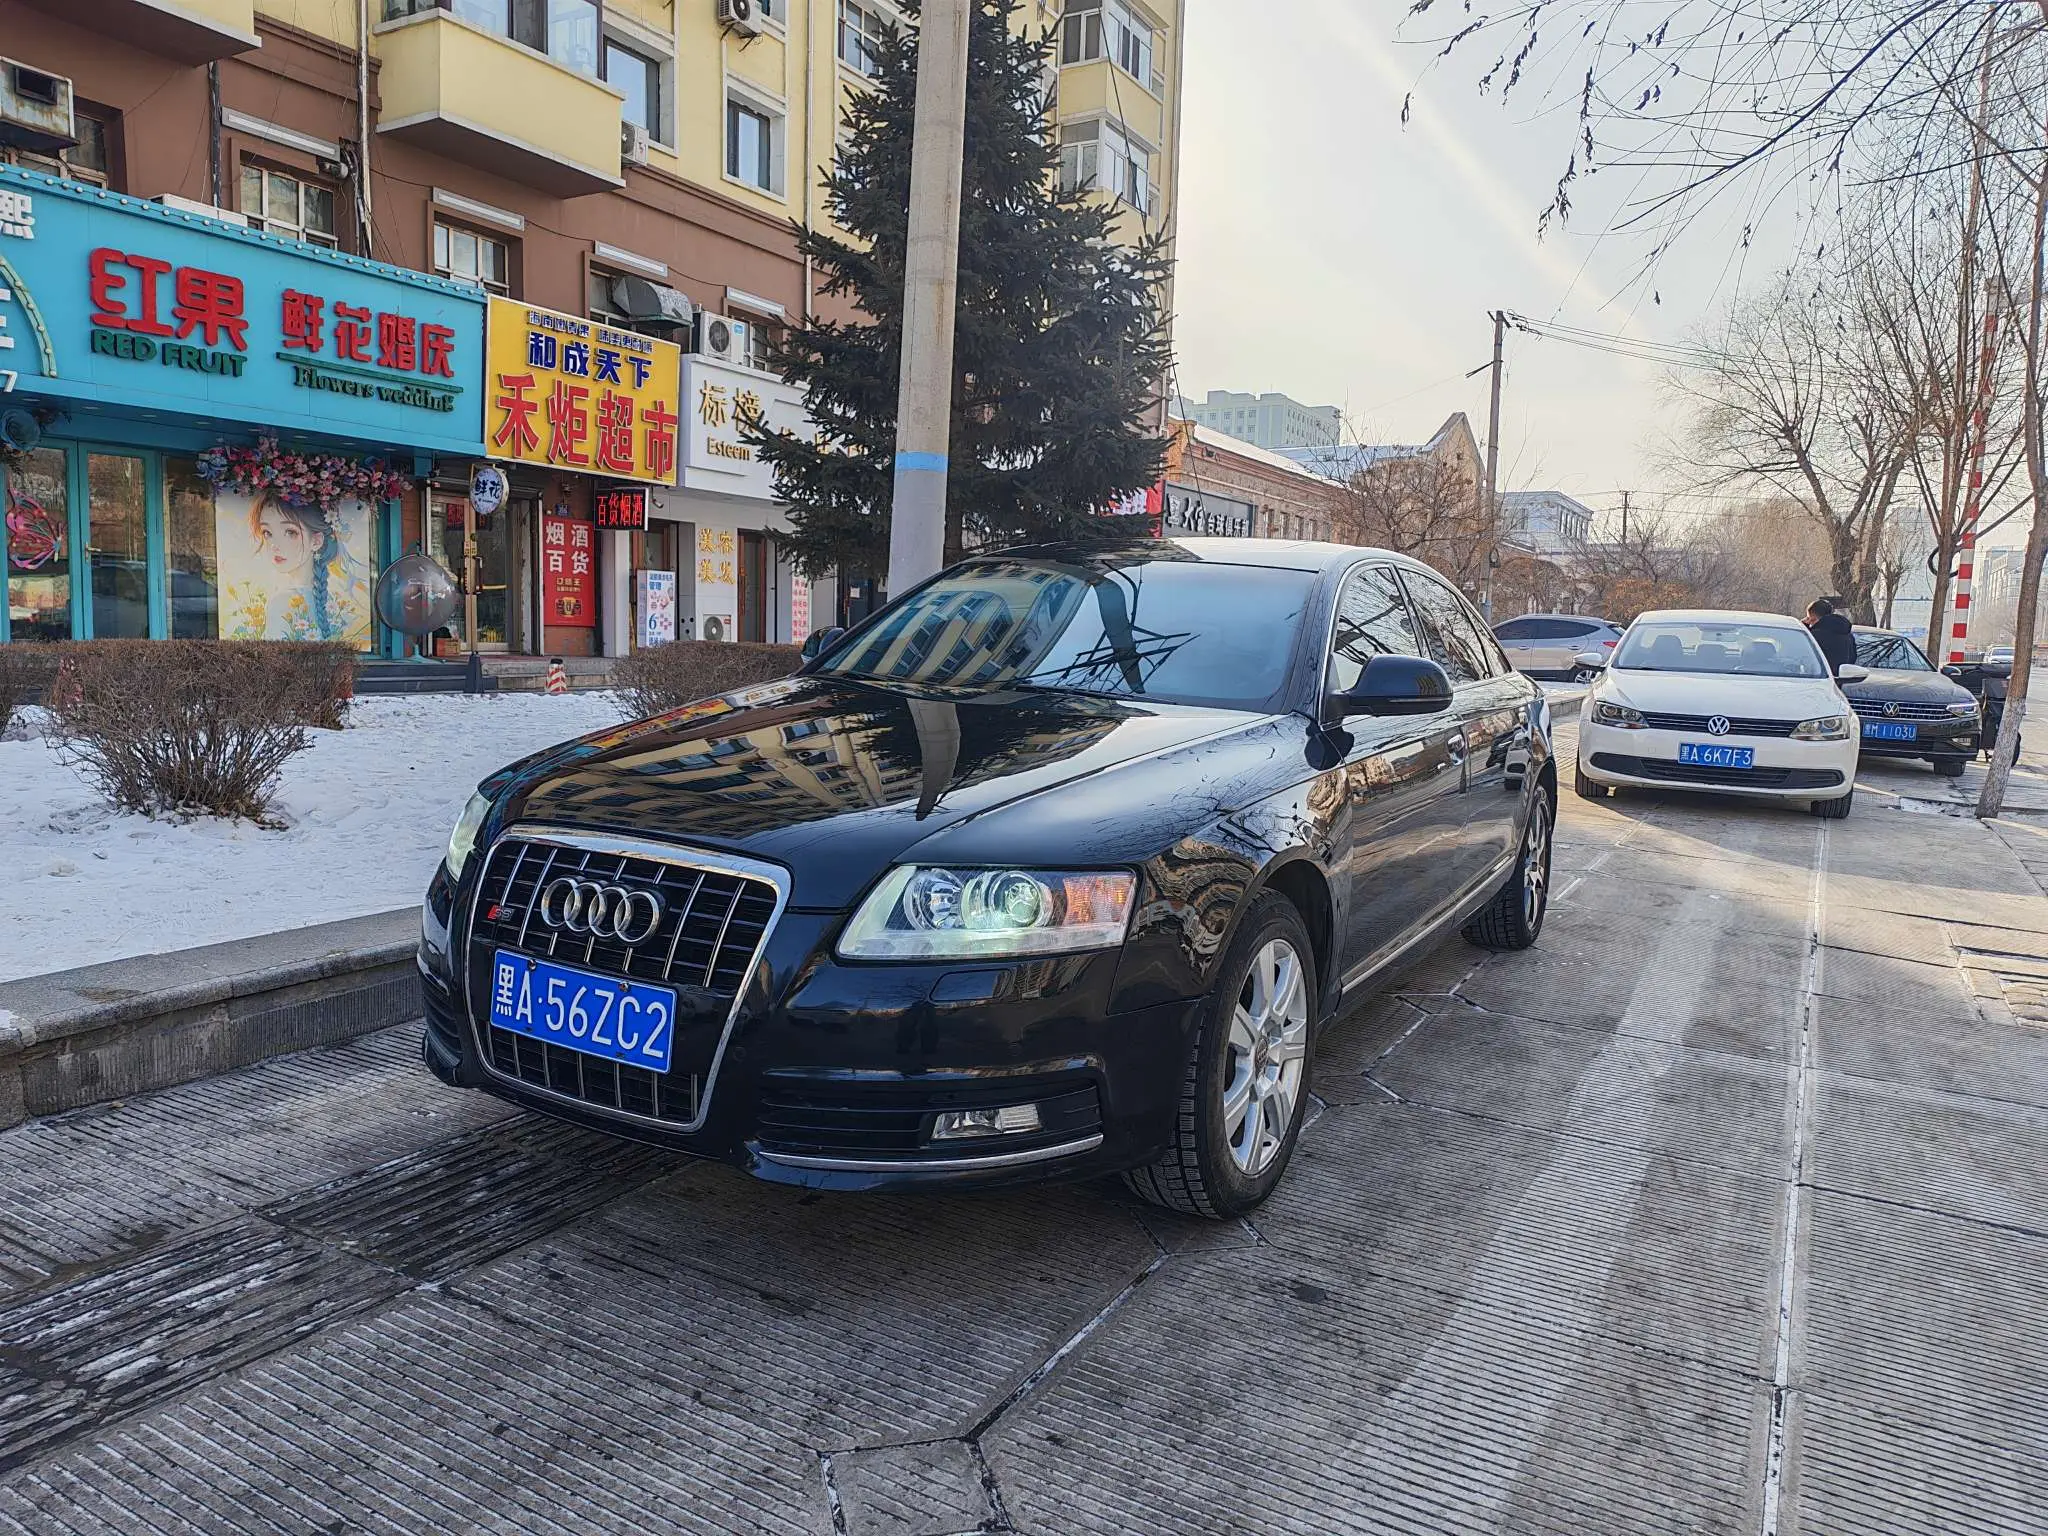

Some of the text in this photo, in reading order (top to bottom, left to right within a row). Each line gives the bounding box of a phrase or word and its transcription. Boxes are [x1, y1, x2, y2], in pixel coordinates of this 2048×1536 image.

[90, 247, 249, 352] 红果
[91, 329, 248, 377] RED FRUIT
[282, 289, 455, 378] 鲜花婚庆
[527, 331, 653, 390] 和成天下
[294, 366, 455, 412] Flowers wedding
[495, 373, 679, 478] 禾炬超市
[707, 436, 750, 461] Esteem
[474, 477, 504, 499] 鲜花
[597, 492, 643, 527] 百货烟酒
[545, 520, 589, 548] 烟酒
[699, 528, 735, 554] 美容
[546, 549, 590, 575] 百货
[495, 963, 668, 1058] 黑A·56ZC2
